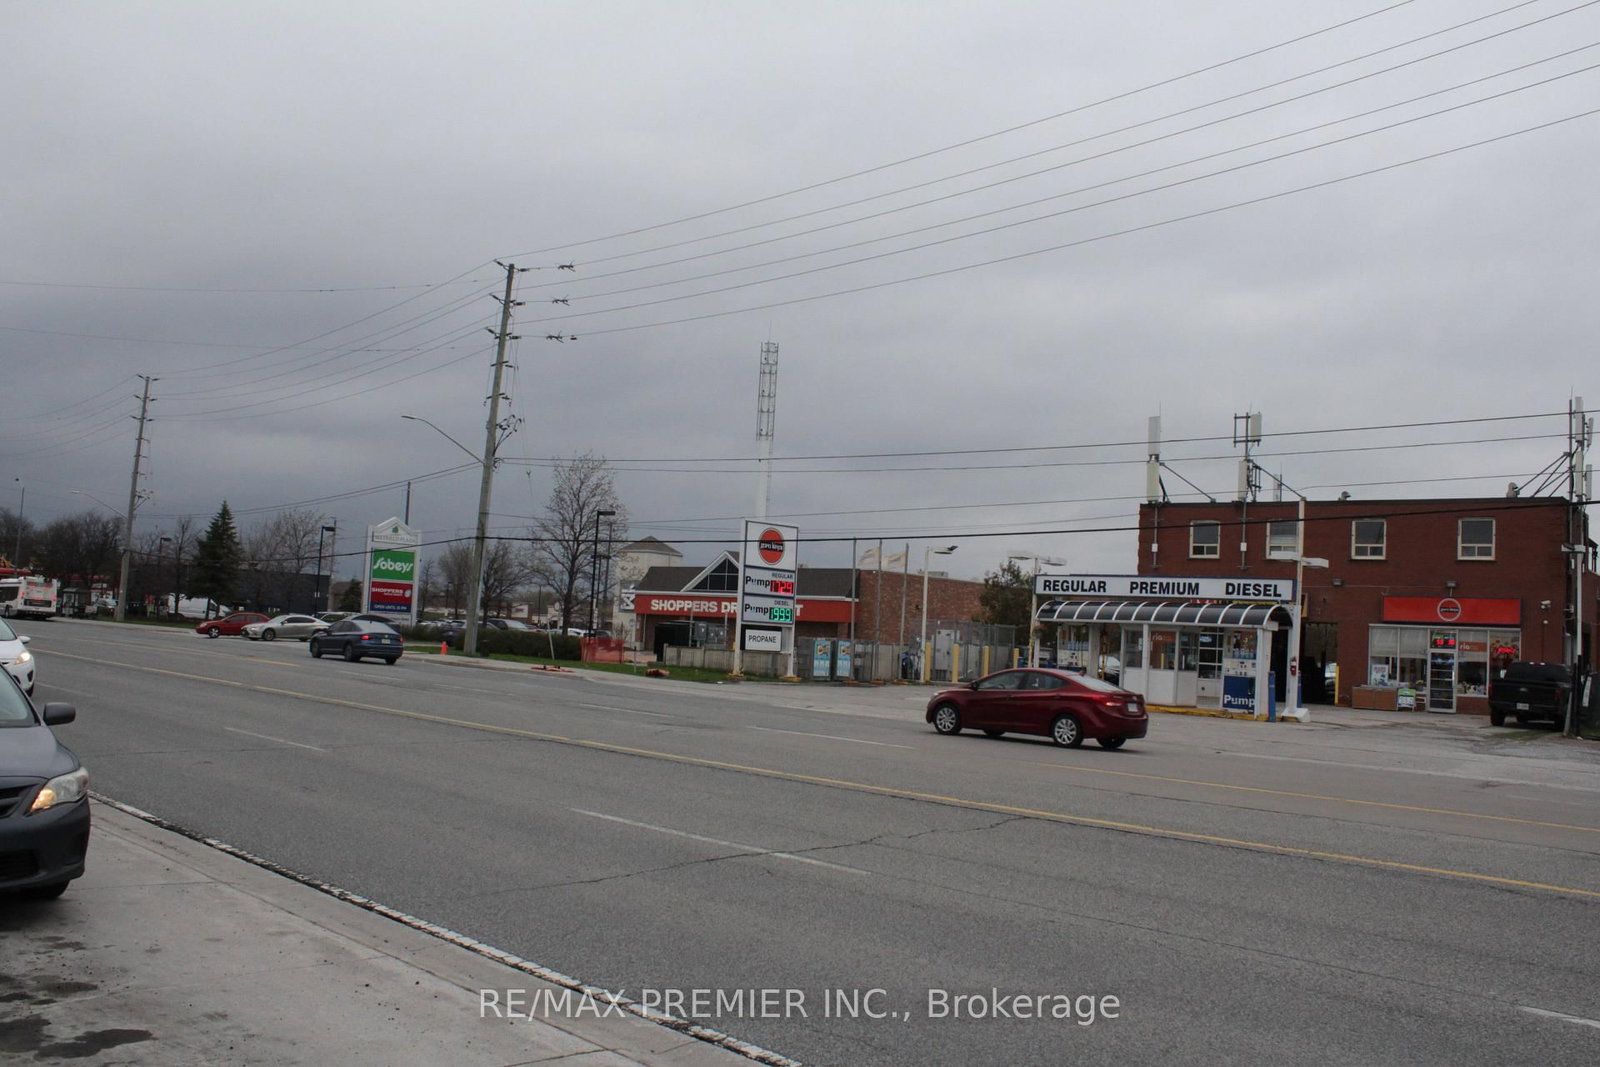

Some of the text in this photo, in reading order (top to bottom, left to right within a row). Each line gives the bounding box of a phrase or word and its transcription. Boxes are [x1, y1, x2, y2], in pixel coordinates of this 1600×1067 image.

[373, 557, 413, 573] Sobeys
[745, 575, 770, 588] Pump
[1043, 579, 1282, 598] REGULAR PREMIUM DIESEL
[650, 599, 718, 613] SHOPPERS
[744, 603, 769, 616] Pump
[748, 634, 777, 644] PROPANE
[1224, 694, 1255, 708] Pump
